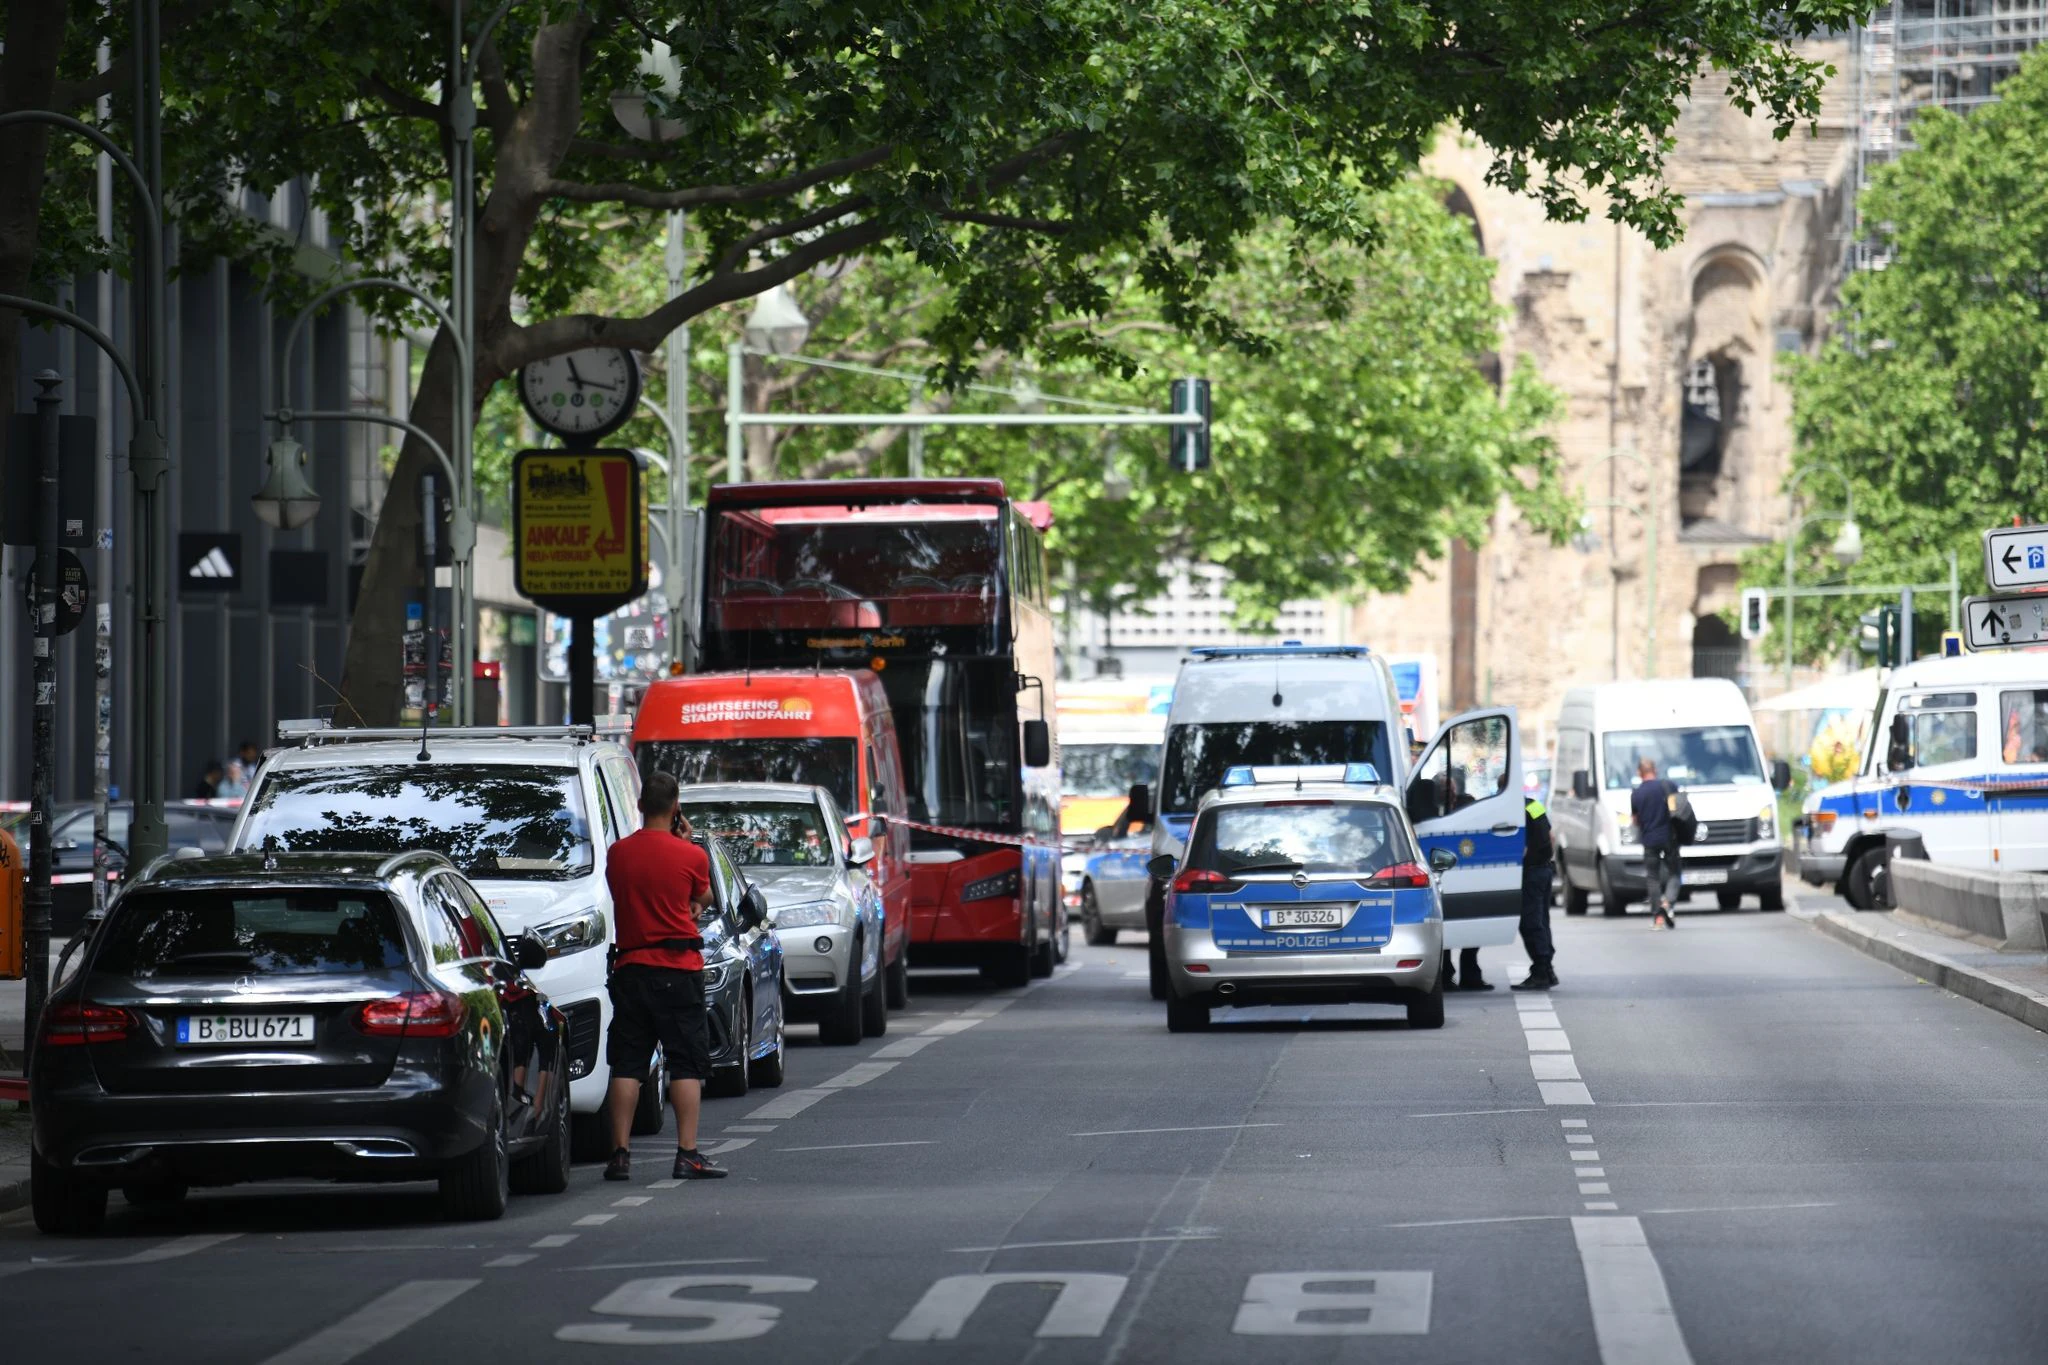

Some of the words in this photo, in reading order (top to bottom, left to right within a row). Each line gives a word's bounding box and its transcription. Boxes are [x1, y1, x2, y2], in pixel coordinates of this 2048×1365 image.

[527, 525, 592, 546] ANKAUF
[681, 699, 779, 714] SIGHTSEEING
[681, 710, 813, 724] STADTRUNDFAHRT
[1276, 911, 1285, 924] B
[1294, 910, 1335, 923] 30326
[1276, 936, 1328, 948] POLIZEI
[199, 1018, 213, 1039] B
[230, 1017, 258, 1038] BU
[263, 1016, 303, 1038] 671
[554, 1270, 1434, 1346] BUS
